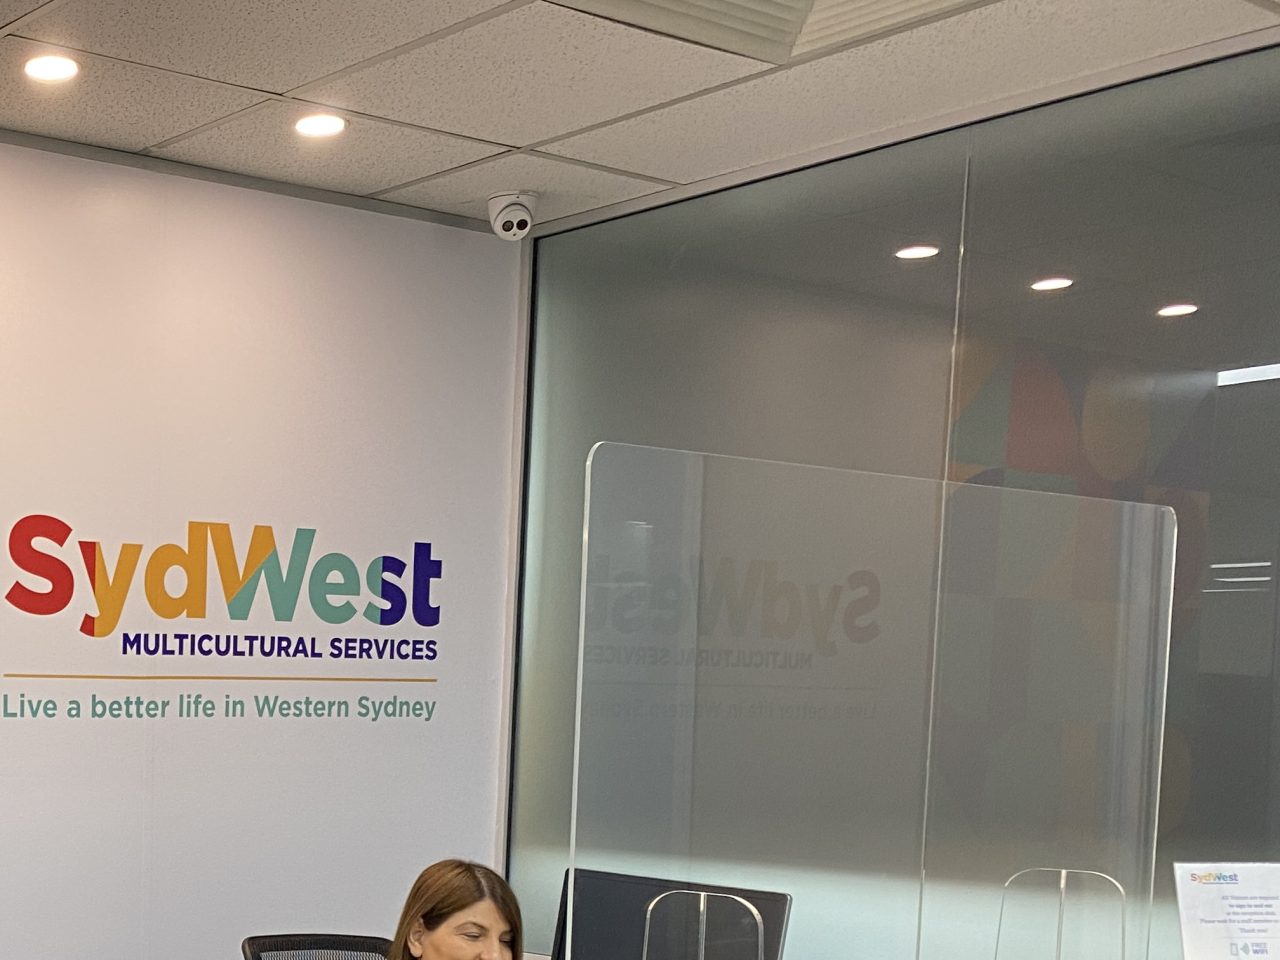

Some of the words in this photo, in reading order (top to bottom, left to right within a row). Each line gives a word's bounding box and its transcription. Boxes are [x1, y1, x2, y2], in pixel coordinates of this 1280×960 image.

[4, 513, 443, 638] SydWest
[121, 633, 323, 659] MULTICULTURAL
[328, 637, 438, 661] SERVICES
[2, 694, 58, 719] Live
[66, 699, 82, 719] a
[91, 694, 170, 719] better
[178, 694, 216, 719] life
[224, 694, 246, 719] in
[253, 695, 350, 719] Western
[357, 695, 437, 722] Sydney
